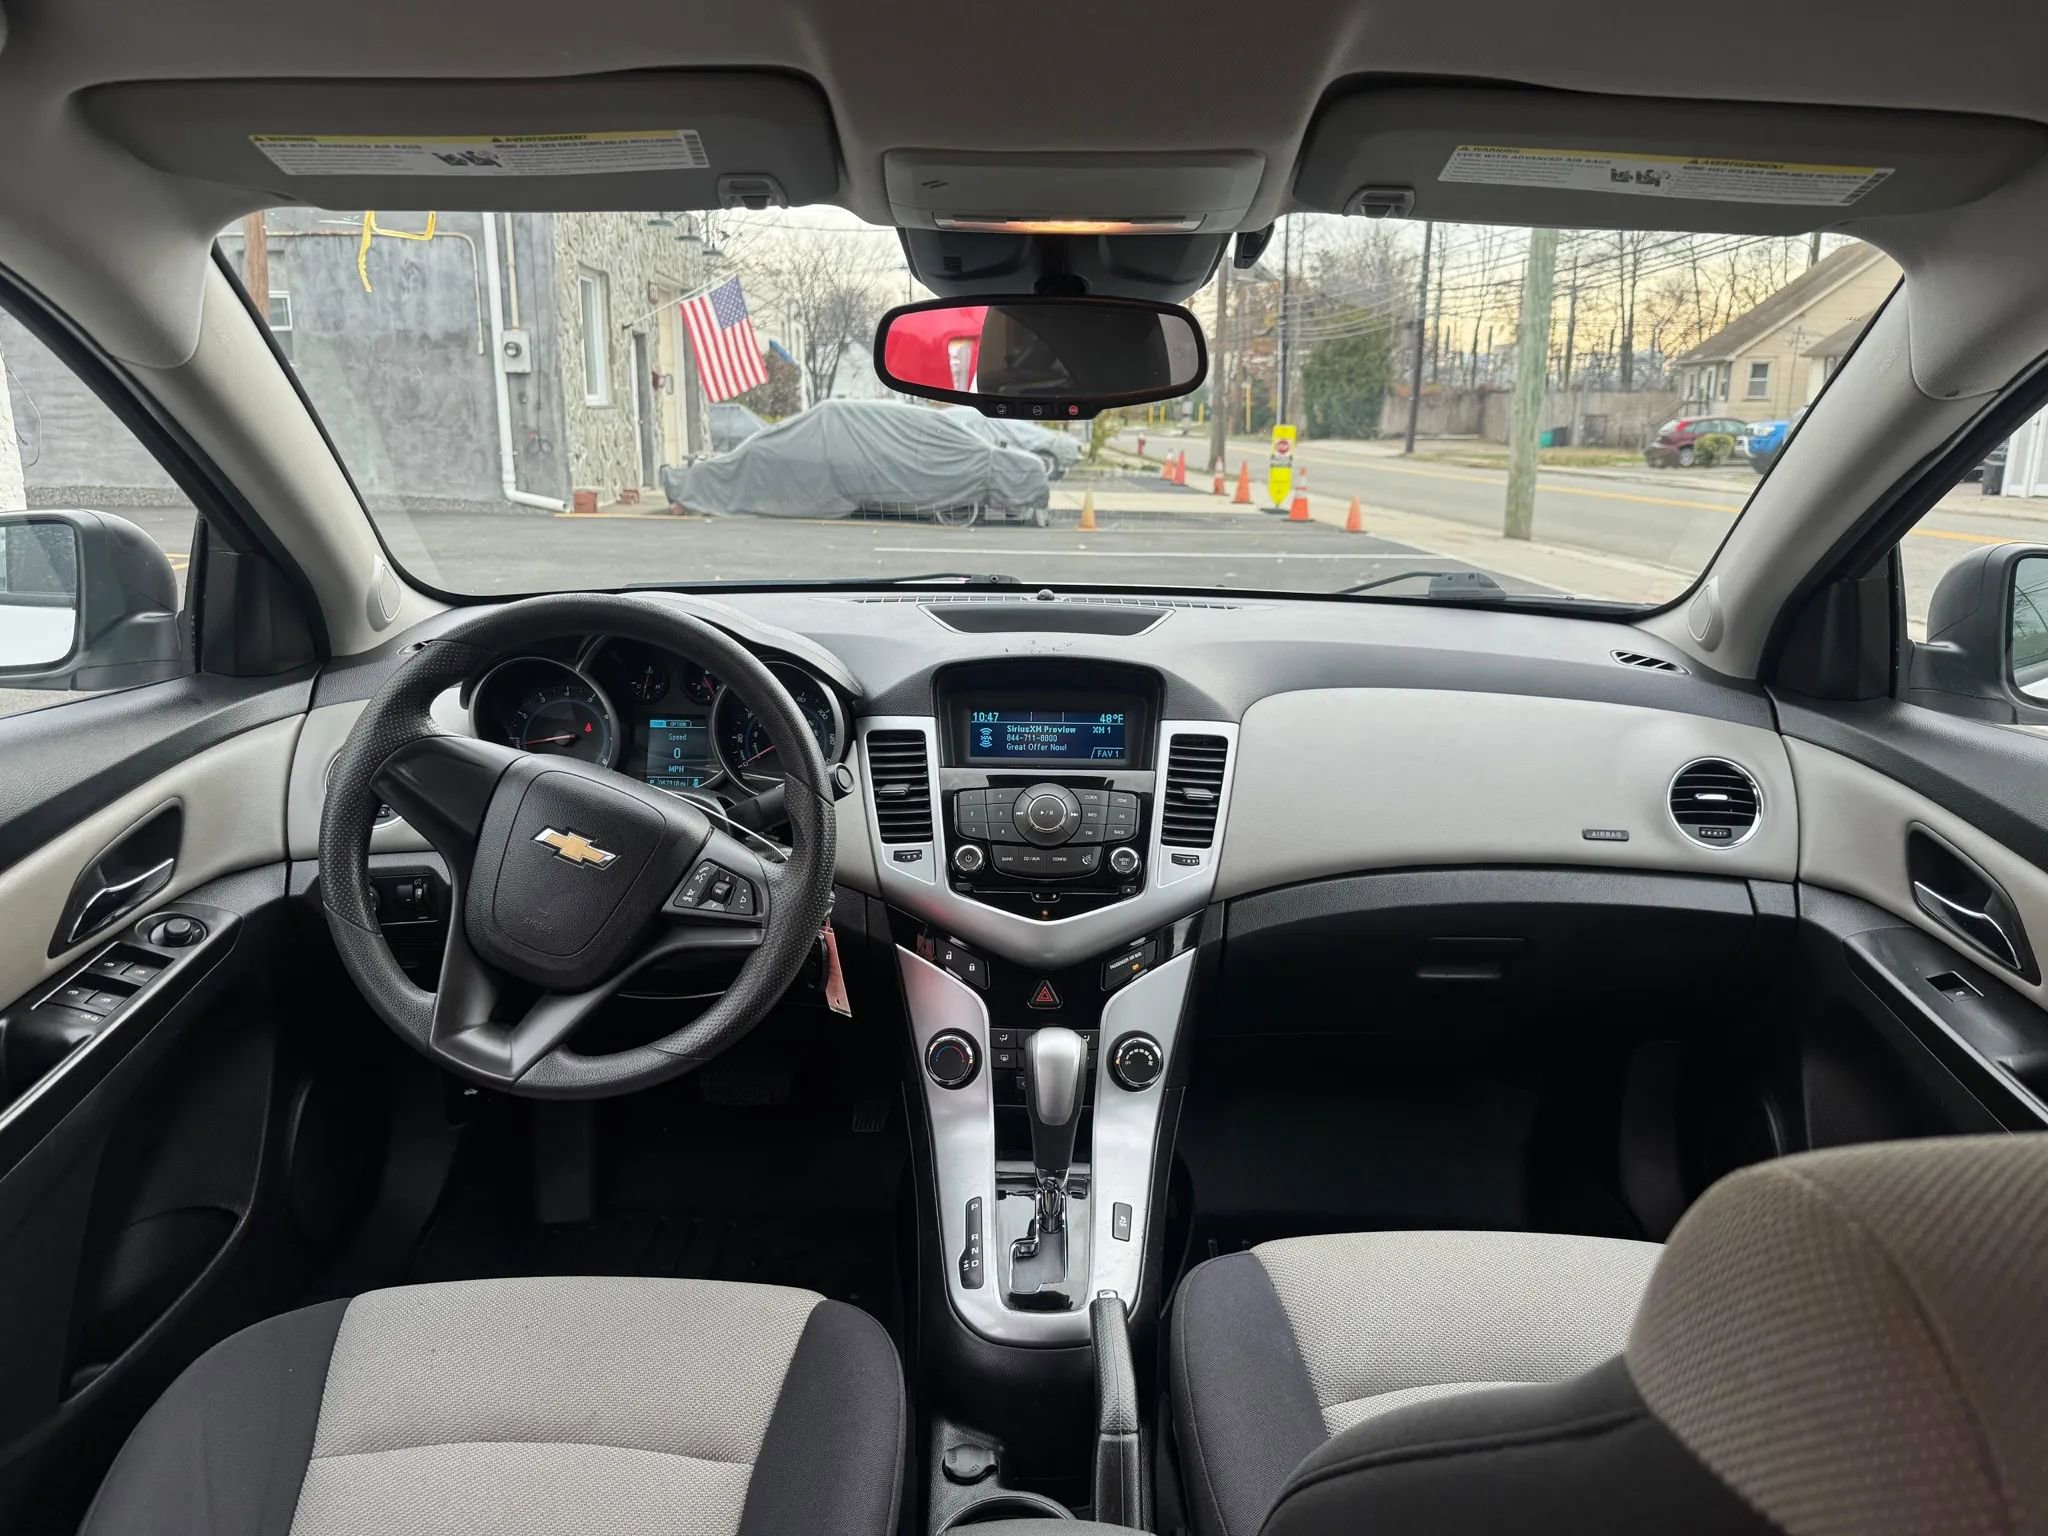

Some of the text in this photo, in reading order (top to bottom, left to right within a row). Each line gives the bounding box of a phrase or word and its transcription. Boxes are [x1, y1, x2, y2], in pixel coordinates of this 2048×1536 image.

[972, 712, 999, 722] 10:47
[1100, 714, 1124, 724] 48°F
[1006, 725, 1076, 734] SiriusXM Preview
[1092, 726, 1105, 734] XM
[668, 733, 687, 741] Speed
[1006, 734, 1058, 742] 844-711-8800
[1006, 743, 1067, 751] Great Offer Now!
[673, 747, 681, 759] 0
[1097, 750, 1113, 758] FAV
[971, 1203, 978, 1211] P
[971, 1233, 979, 1241] R
[971, 1247, 979, 1255] N
[971, 1260, 979, 1268] D
